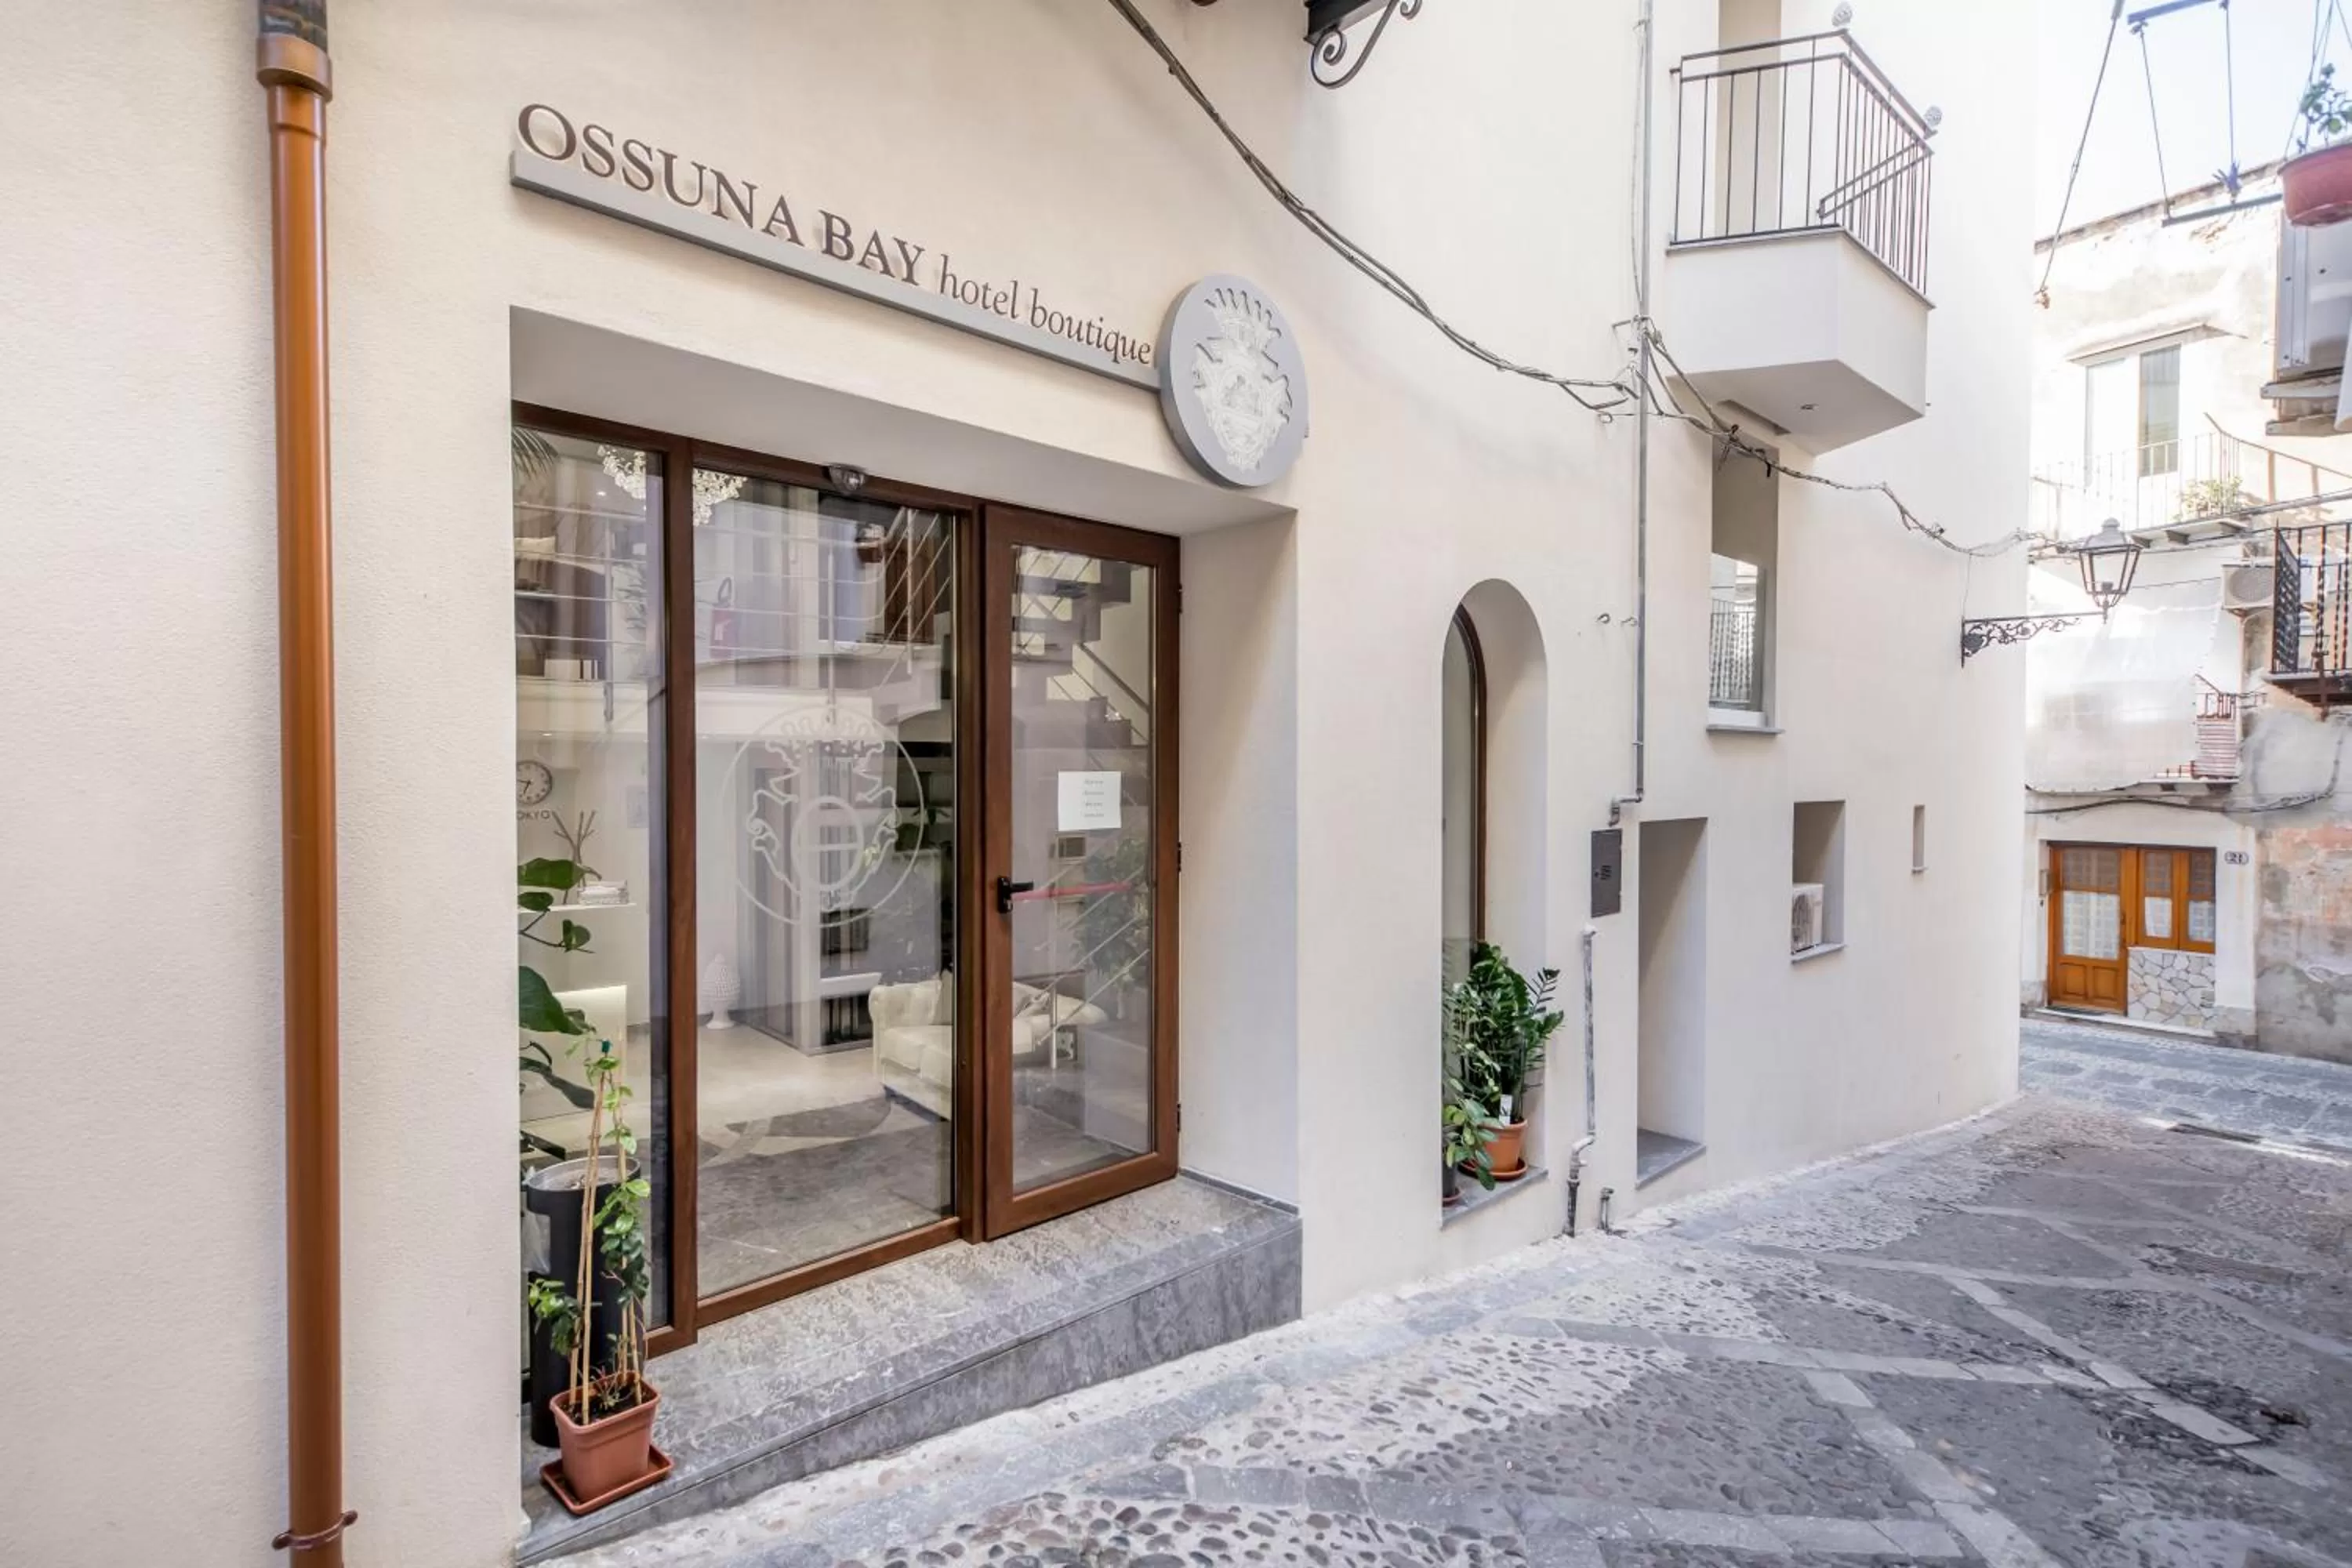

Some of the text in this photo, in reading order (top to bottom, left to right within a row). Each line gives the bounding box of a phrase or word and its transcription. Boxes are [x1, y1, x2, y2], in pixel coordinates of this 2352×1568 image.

[518, 103, 1152, 365] OSSUNA BAY hotel boutique
[517, 810, 550, 820] OKYO
